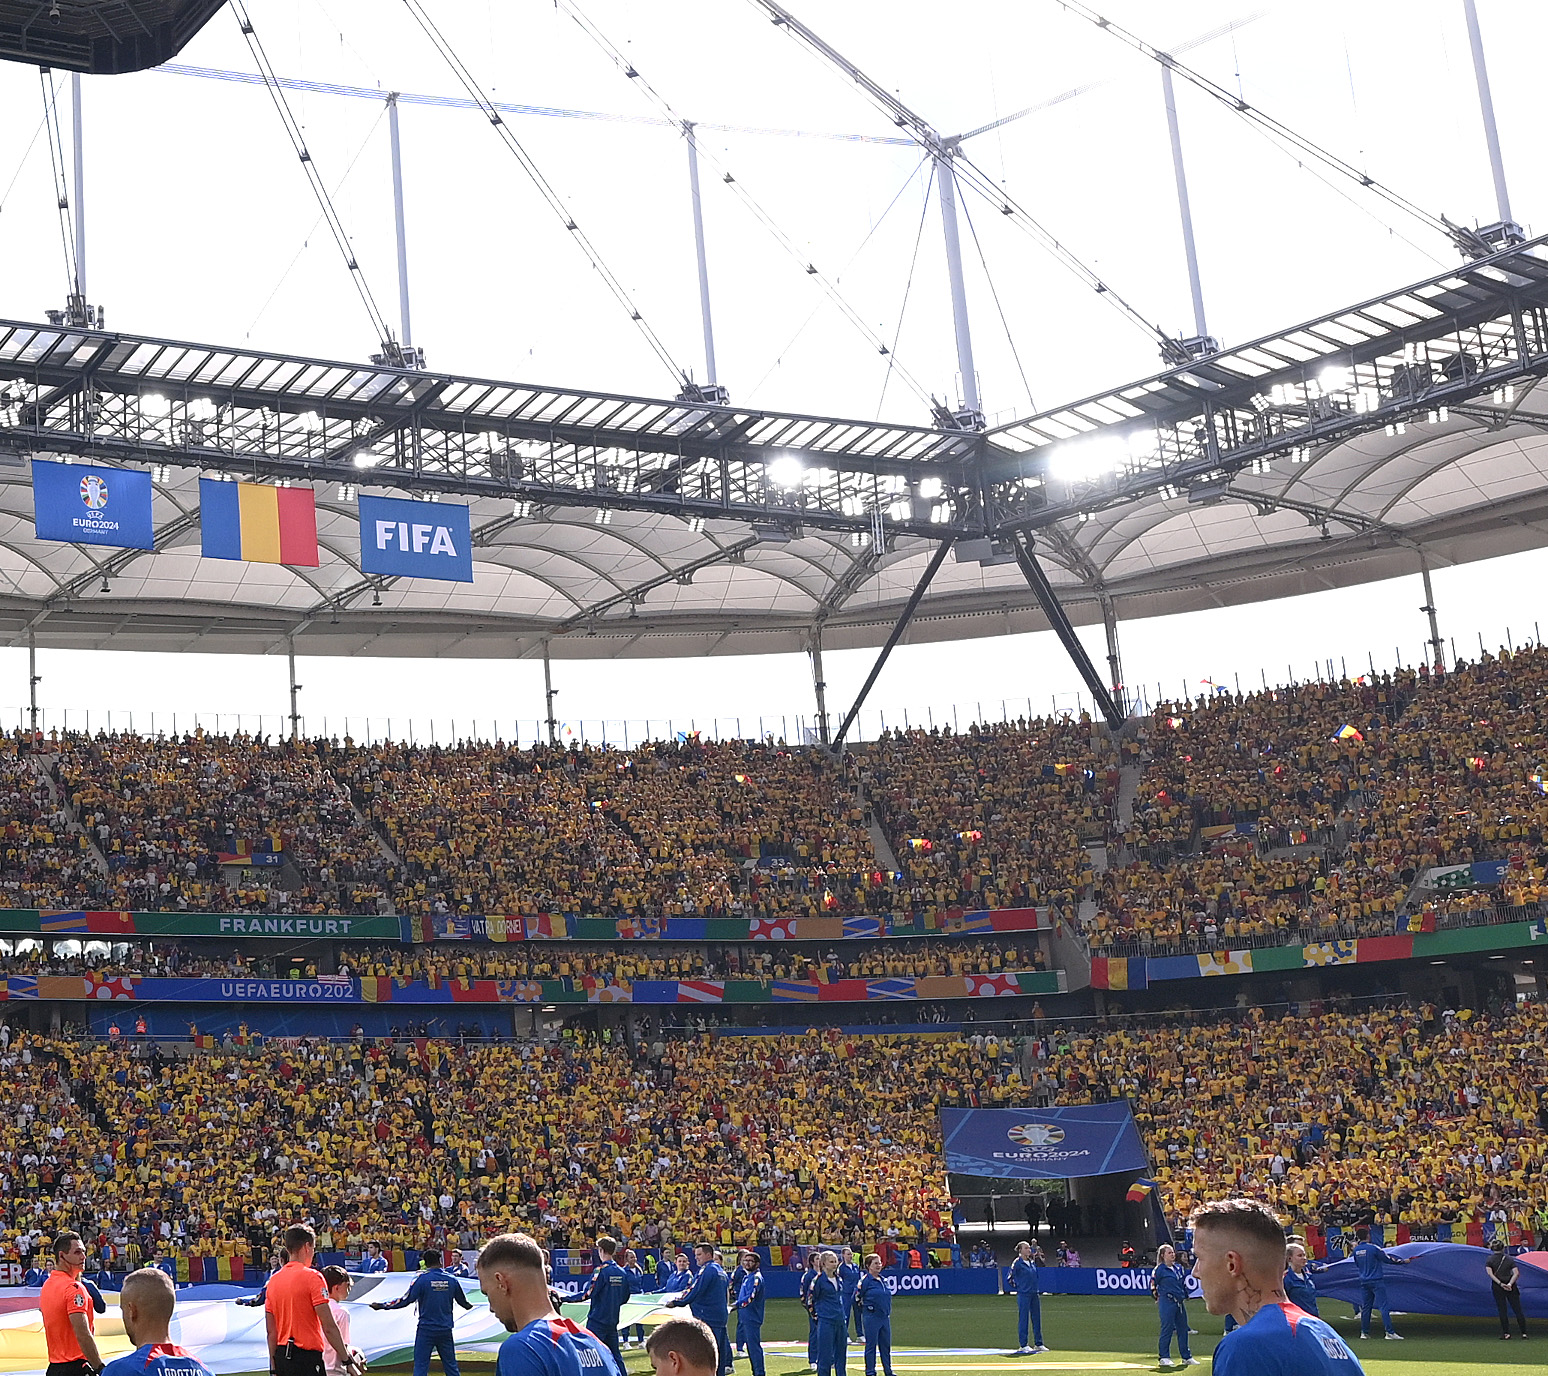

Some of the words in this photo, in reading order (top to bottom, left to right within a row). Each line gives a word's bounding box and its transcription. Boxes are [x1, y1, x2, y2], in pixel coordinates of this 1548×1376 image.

[375, 520, 458, 557] FIFA
[265, 855, 279, 864] 31
[219, 918, 352, 934] FRANKFURT
